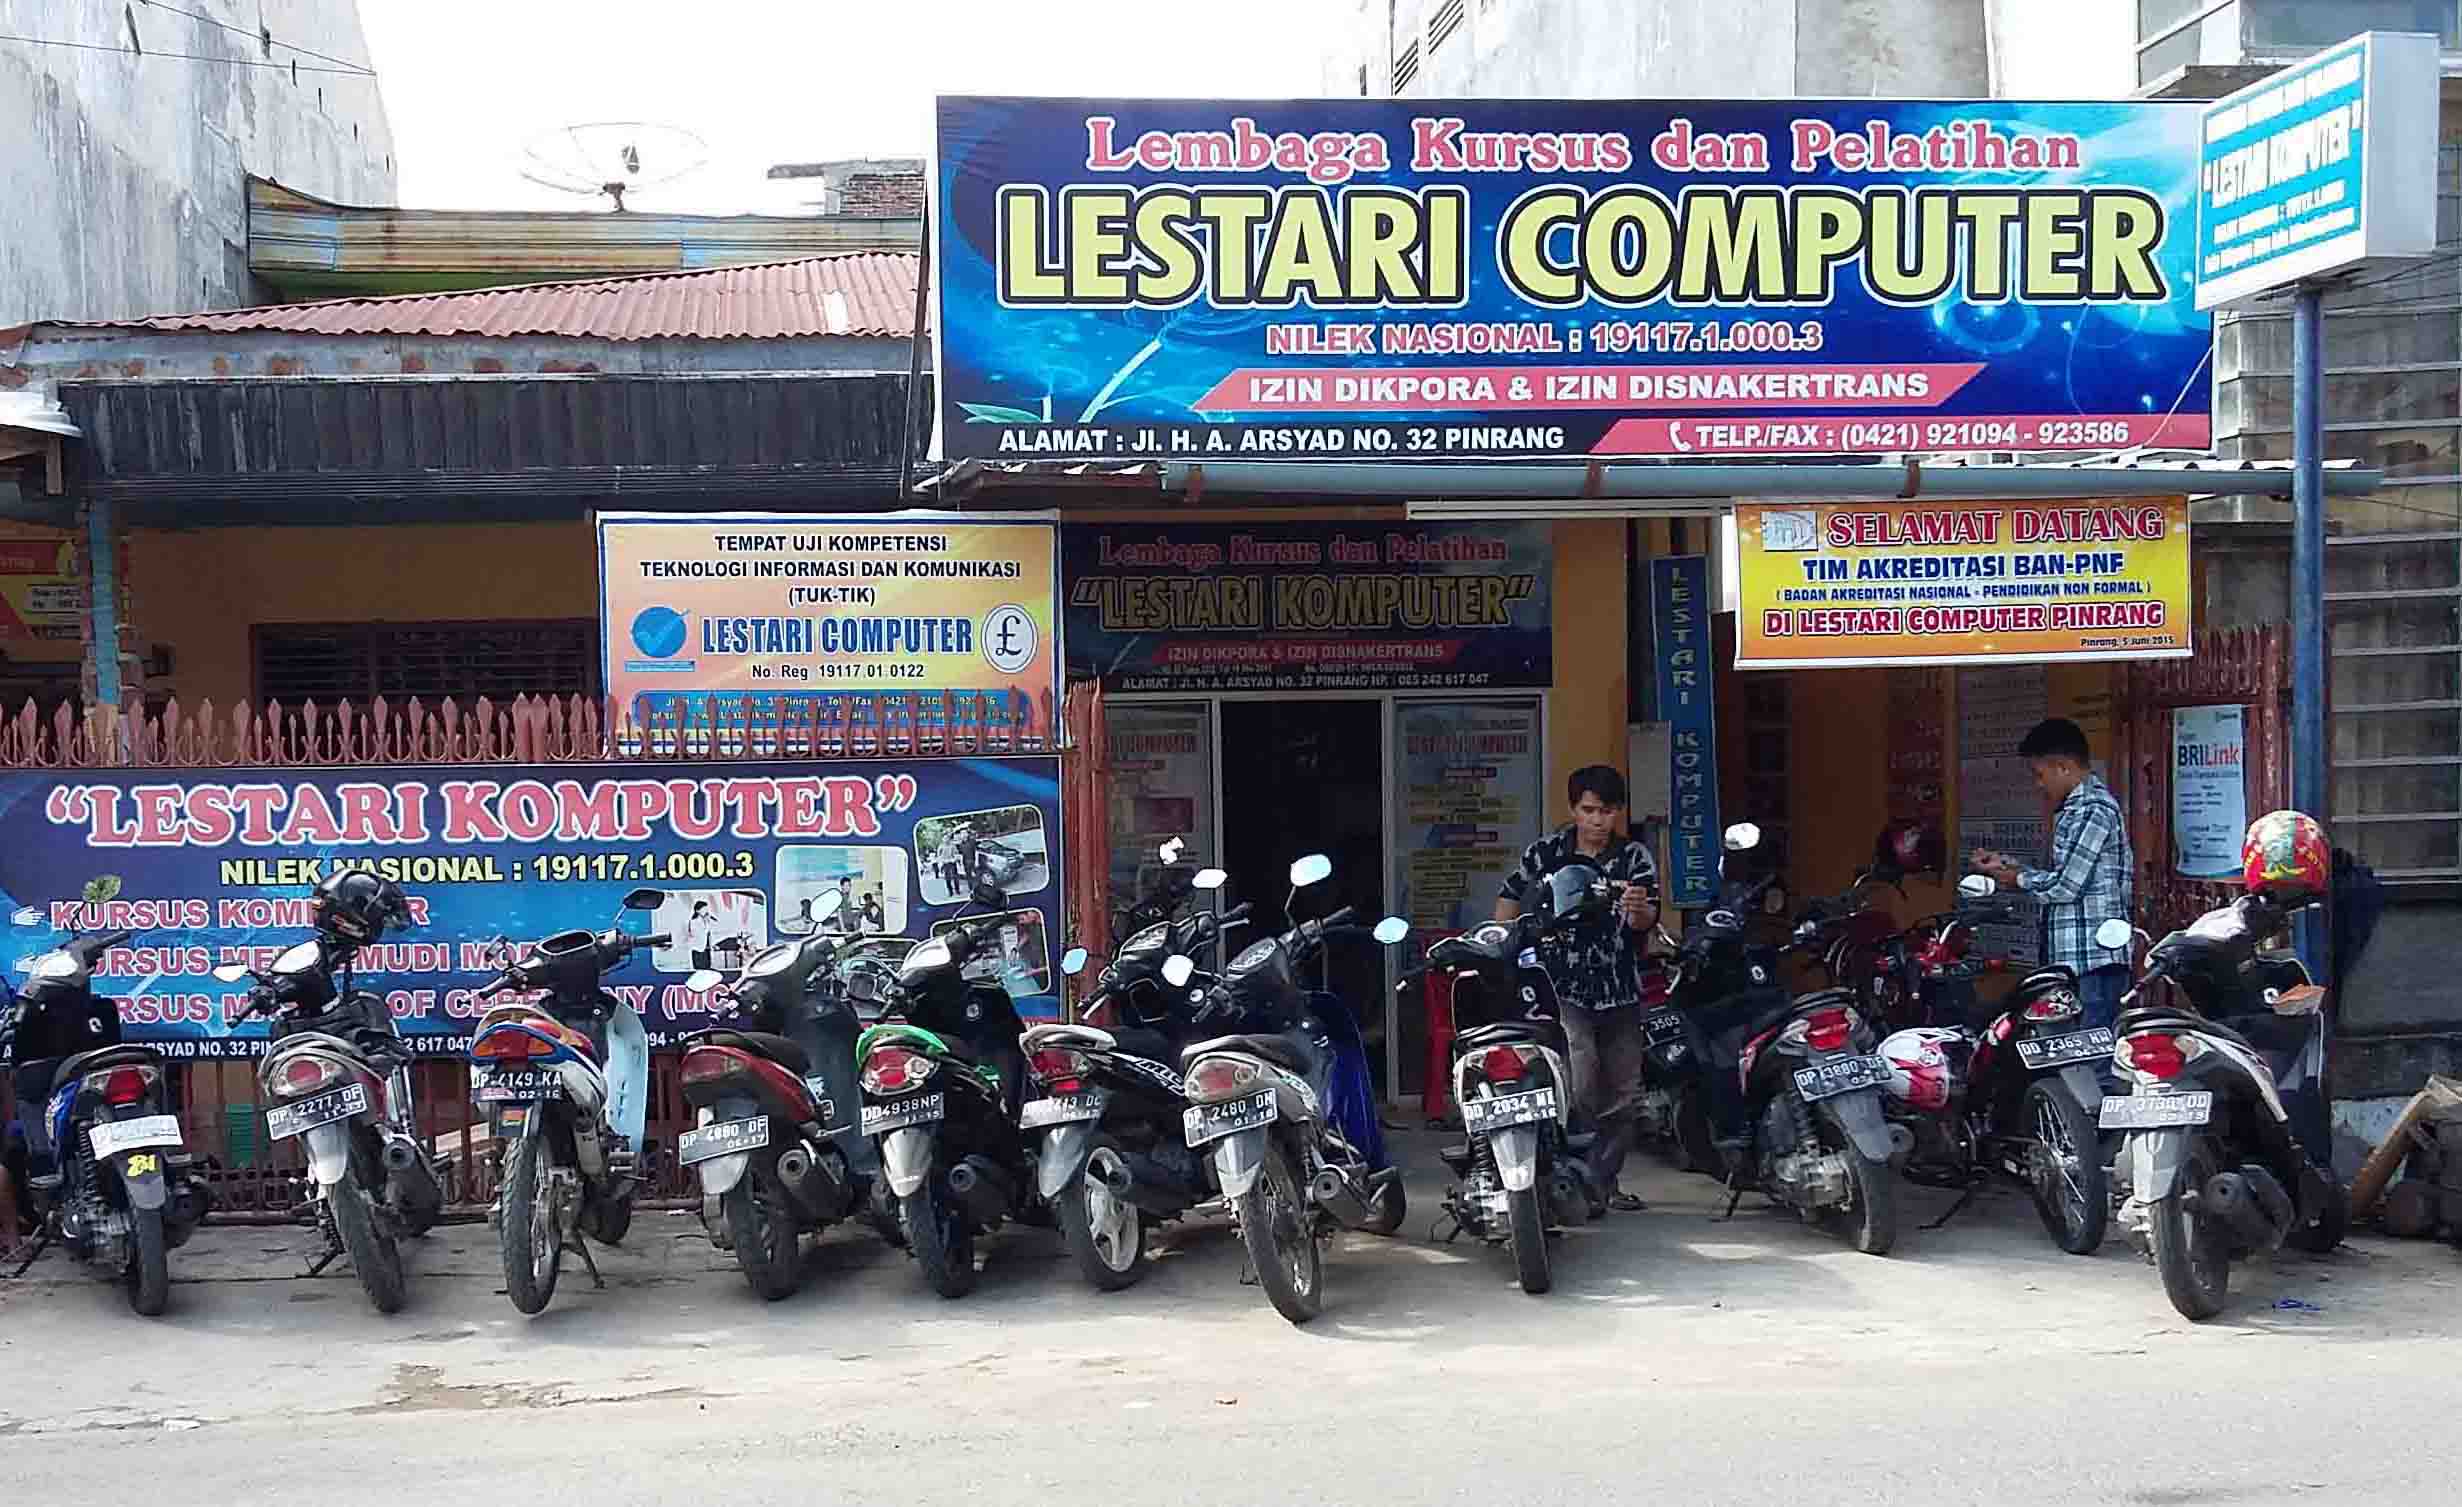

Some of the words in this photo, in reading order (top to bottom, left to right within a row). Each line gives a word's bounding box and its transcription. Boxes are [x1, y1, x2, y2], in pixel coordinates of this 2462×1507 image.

[1087, 116, 1387, 184] Lembaga
[1411, 117, 1631, 172] Kursus
[1652, 119, 1770, 171] dan
[1792, 119, 2080, 171] Pelatihan
[997, 184, 1470, 308] LESTARI
[1499, 183, 2168, 306] COMPUTER
[1265, 324, 1373, 354] NILEK
[1381, 323, 1560, 353] NASIONAL
[1568, 326, 1582, 352] :
[1589, 320, 1824, 352] 19117.1.000.3
[1248, 375, 1325, 403] IZIN
[1341, 374, 1496, 402] DIKPORA
[1508, 374, 1534, 401] &
[1545, 373, 1617, 401] IZIN
[1629, 371, 1930, 400] DISNAKERTRANS
[998, 428, 1108, 452] ALAMAT
[1116, 434, 1124, 451] :
[1171, 429, 1198, 451] H.
[1205, 429, 1233, 451] A.
[1240, 429, 1345, 451] ARSYAD
[1353, 429, 1400, 451] NO.
[1406, 428, 1438, 451] 32
[1445, 427, 1565, 451] PINRANG
[1695, 424, 1819, 448] TELP./FAX
[1825, 428, 1834, 446] :
[1840, 422, 1919, 451] (0421)
[1926, 423, 2017, 447] 921094
[2039, 421, 2130, 446] 923586
[1827, 511, 2003, 546] SELAMAT
[2013, 506, 2165, 542] DATANG
[715, 535, 787, 552] TEMPAT
[792, 535, 823, 552] UJI
[829, 535, 947, 551] KOMPETENSI
[1099, 535, 1221, 568] Lembaga
[1230, 535, 1321, 565] Kursus
[1331, 535, 1378, 563] dan
[1386, 535, 1510, 563] Pelatihan
[640, 561, 748, 578] TEKNOLOGI
[754, 561, 857, 578] INFORMASI
[861, 561, 898, 578] DAN
[903, 560, 1021, 578] KOMUNIKASI
[1803, 559, 1848, 580] TIM
[1856, 554, 2005, 578] AKREDITASI
[2013, 552, 2125, 576] BAN-PNF
[788, 587, 876, 608] (TUK-TIK)
[1784, 588, 1828, 601] BADAN
[1831, 586, 1906, 600] AKREDITASI
[1909, 585, 1972, 599] NASIONAL
[1982, 584, 2060, 597] PENDIDIKAN
[2064, 583, 2089, 595] NON
[2093, 581, 2143, 595] FORMAL
[1764, 609, 1794, 636] DI
[1798, 608, 1901, 634] LESTARI
[1905, 604, 2047, 632] COMPUTER
[2050, 601, 2164, 629] PINRANG
[702, 617, 813, 655] LESTARI
[820, 616, 973, 655] COMPUTER
[1671, 566, 1698, 706] LESTARI
[2121, 636, 2129, 646] 5
[2152, 635, 2175, 645] 2015
[1168, 646, 1201, 660] IZIN
[1287, 646, 1317, 660] IZIN
[1321, 644, 1444, 659] DISNAKERTRANS
[781, 664, 809, 681] Reg
[1122, 677, 1168, 689] ALAMAT
[1227, 676, 1273, 688] ARSYAD
[1299, 675, 1313, 687] 32
[1315, 674, 1368, 687] PINRANG
[1444, 673, 1465, 686] 617
[1468, 673, 1489, 685] 047
[2178, 743, 2240, 767] BRILink
[47, 781, 427, 847] “LESTARI
[442, 776, 916, 842] KOMPUTER”
[1674, 730, 1709, 892] KOMPUTER
[221, 859, 323, 885] NILEK
[514, 860, 523, 881] :
[533, 853, 754, 881] 19117.1.000.3
[51, 900, 210, 930] KURSUS
[386, 990, 437, 1019] OF
[199, 1042, 226, 1056] NO.
[229, 1041, 246, 1056] 32
[416, 1037, 442, 1051] 617
[447, 1036, 473, 1050] 047
[471, 1072, 489, 1089] DP
[542, 1071, 562, 1087] KA
[1797, 1071, 1817, 1086] DP
[271, 1109, 288, 1125] DP
[297, 1095, 333, 1116] 2277
[341, 1086, 361, 1102] DF
[882, 1098, 920, 1117] 4938
[920, 1094, 940, 1109] NP
[1210, 1100, 1246, 1121] 2480
[682, 1133, 697, 1149] DP
[748, 1118, 767, 1134] DF
